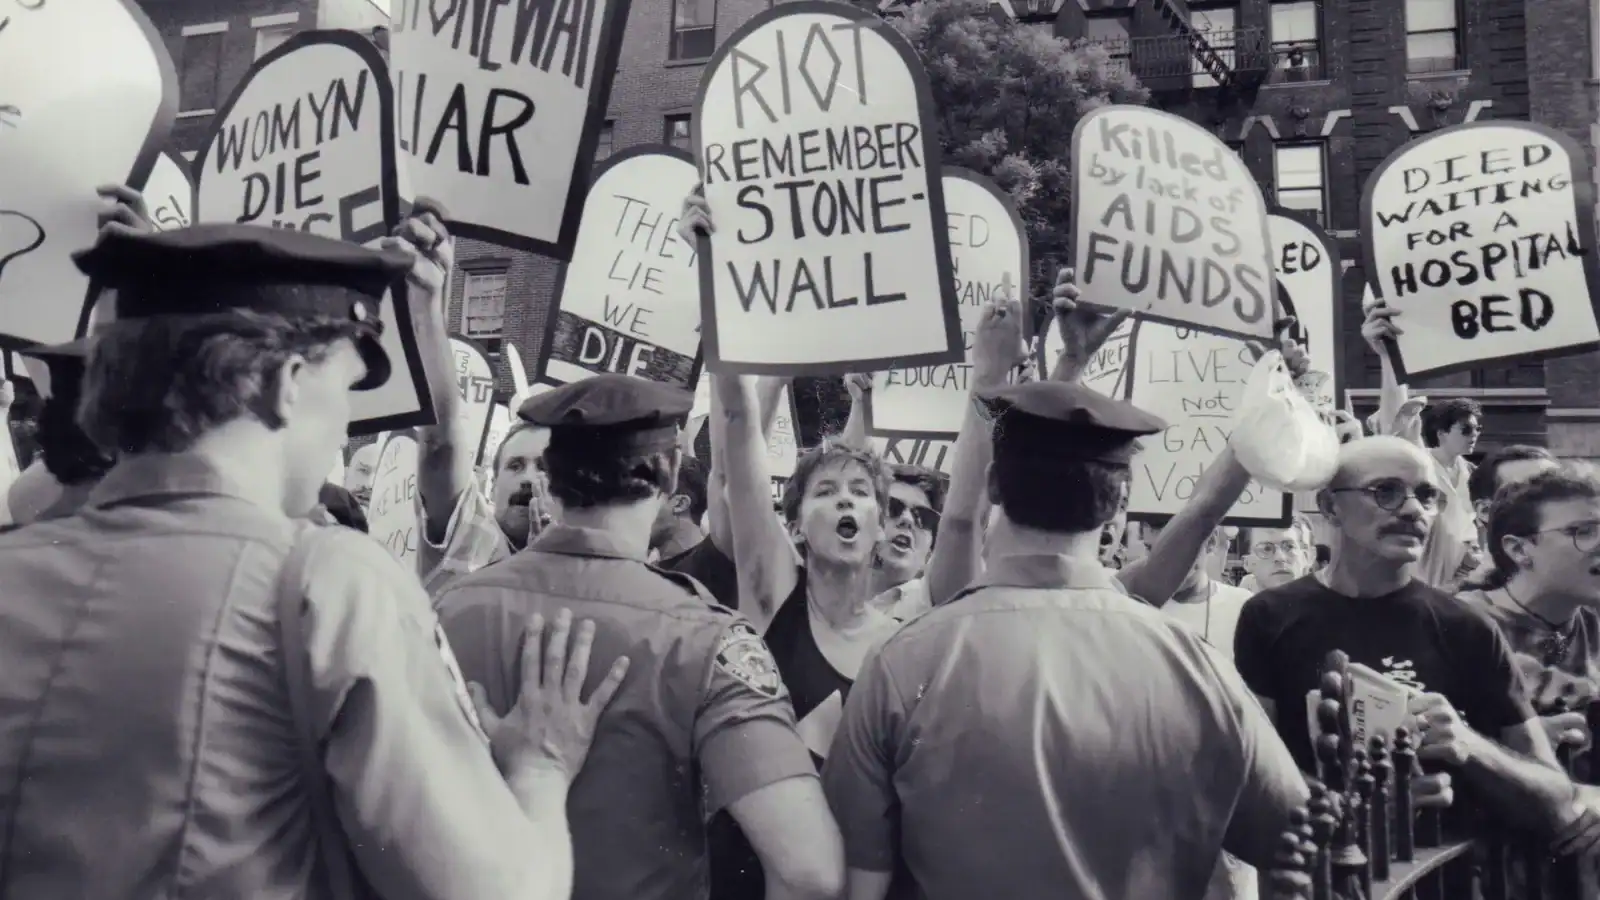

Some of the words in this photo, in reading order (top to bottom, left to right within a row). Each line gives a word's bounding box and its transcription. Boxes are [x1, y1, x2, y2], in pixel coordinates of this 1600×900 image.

[729, 22, 882, 129] RIOT
[216, 69, 368, 174] WOMYN
[398, 70, 536, 186] LIAR
[1099, 117, 1228, 181] Killed
[706, 122, 921, 185] REMEMBER
[1088, 153, 1128, 185] by
[1136, 166, 1198, 202] lack
[1209, 187, 1244, 214] of
[1403, 144, 1552, 194] DIED
[236, 150, 323, 224] DIE
[736, 174, 925, 244] STONE-
[1376, 173, 1571, 228] WAITING
[947, 212, 990, 248] ED
[1100, 192, 1241, 257] AIDS
[1407, 221, 1473, 250] FOR
[1493, 211, 1519, 233] A
[608, 250, 664, 294] LIE
[726, 252, 907, 315] WALL
[1083, 231, 1265, 324] FUNDS
[1275, 240, 1320, 274] ED
[1391, 221, 1588, 297] HOSPITAL
[604, 294, 654, 337] WE
[1451, 288, 1555, 339] BED
[888, 365, 974, 391] EDUCAT
[1163, 425, 1233, 453] GAY
